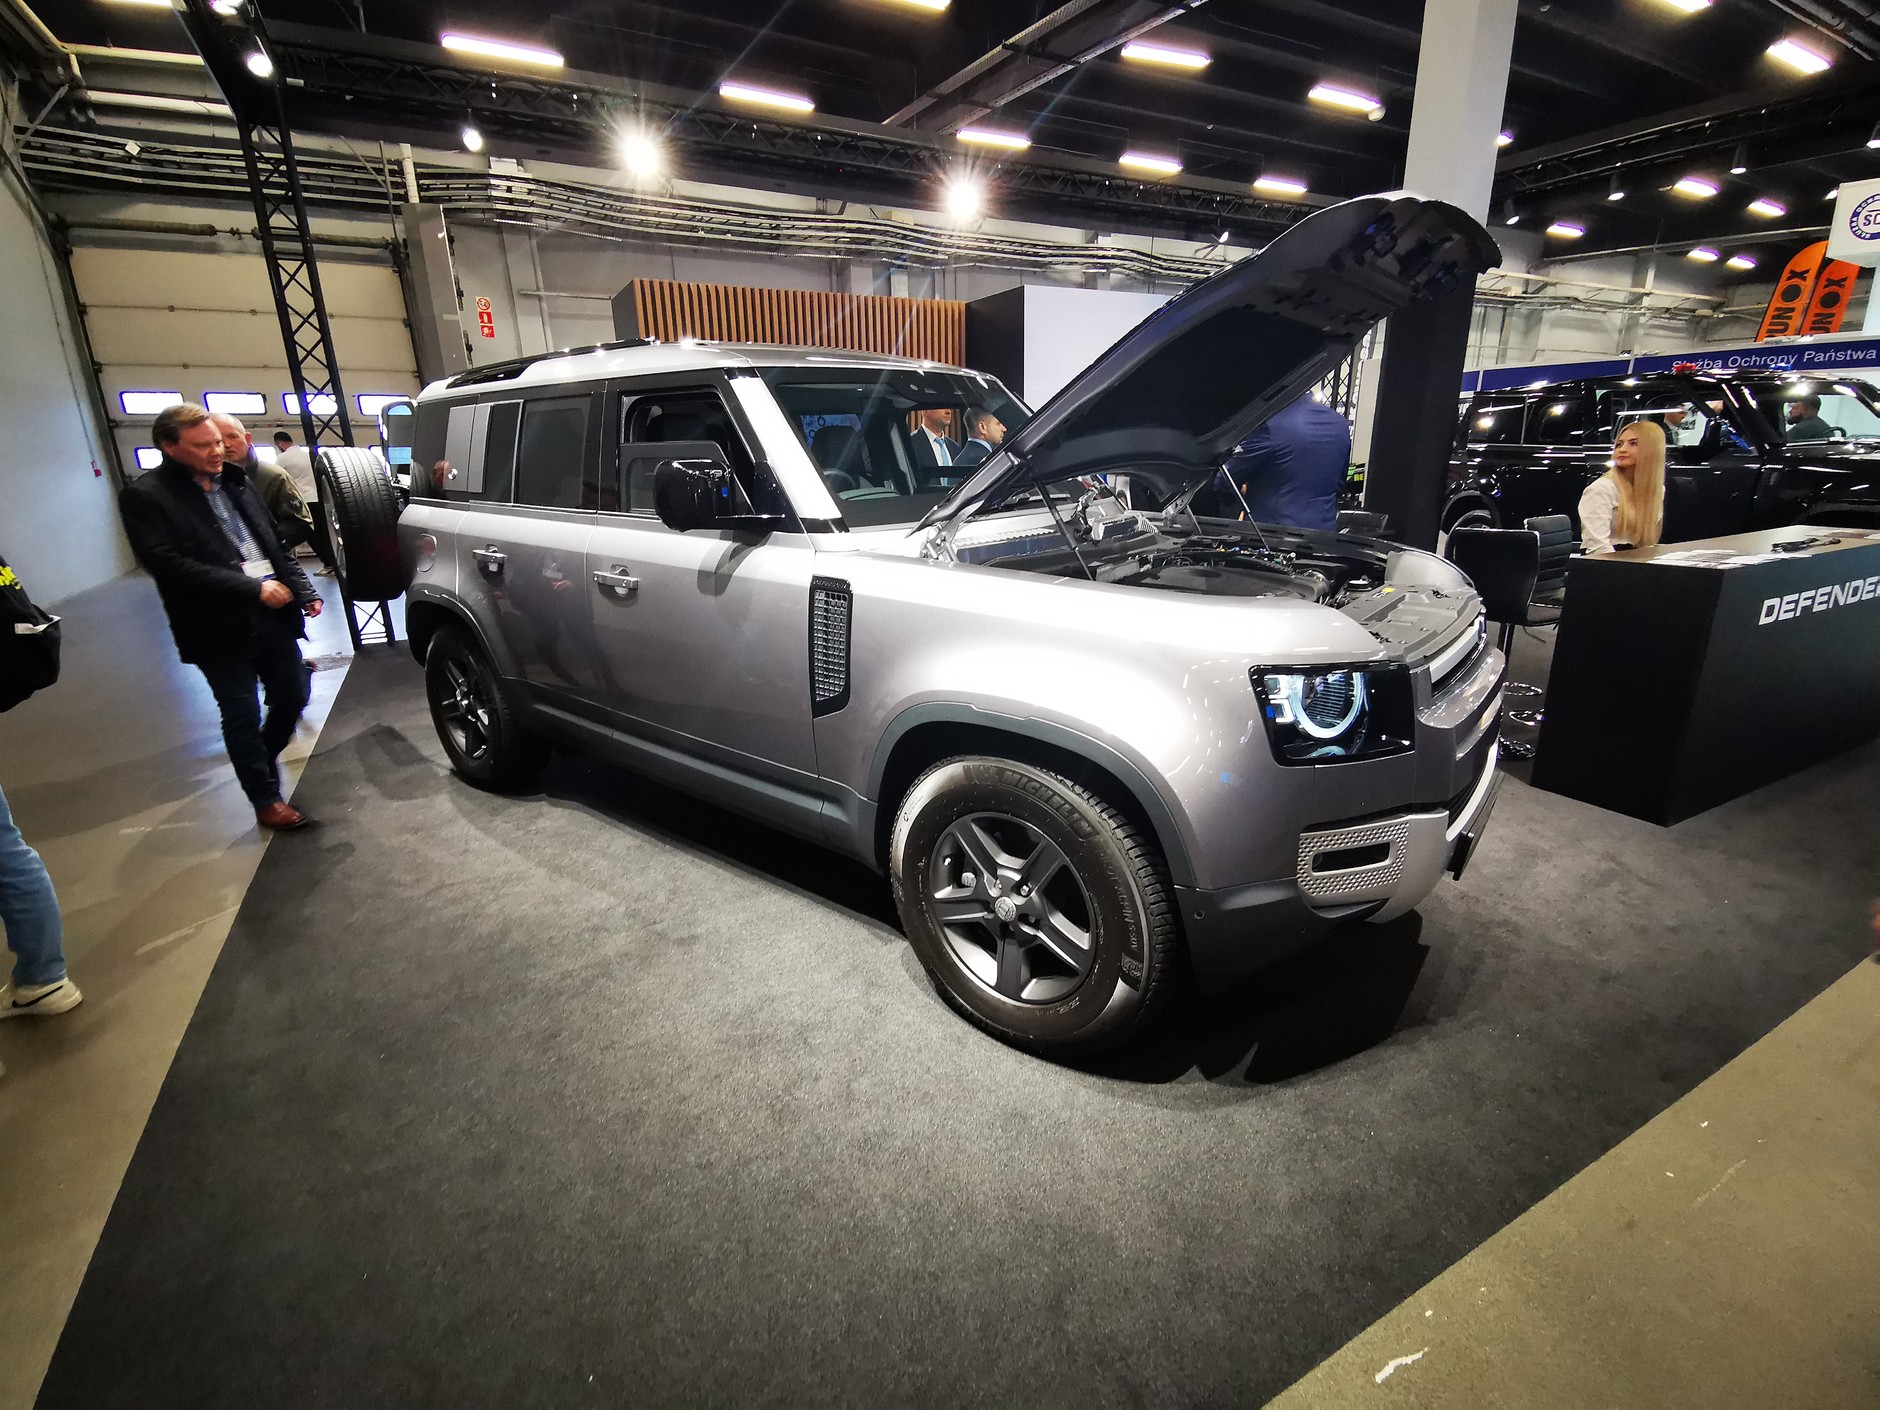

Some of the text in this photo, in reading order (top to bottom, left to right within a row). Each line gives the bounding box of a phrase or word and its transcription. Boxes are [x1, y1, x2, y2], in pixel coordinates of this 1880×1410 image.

[1765, 268, 1811, 337] UNOX
[1728, 353, 1798, 368] Ochrony
[1803, 348, 1876, 363] Państwa
[1758, 576, 1880, 625] DEFENDE
